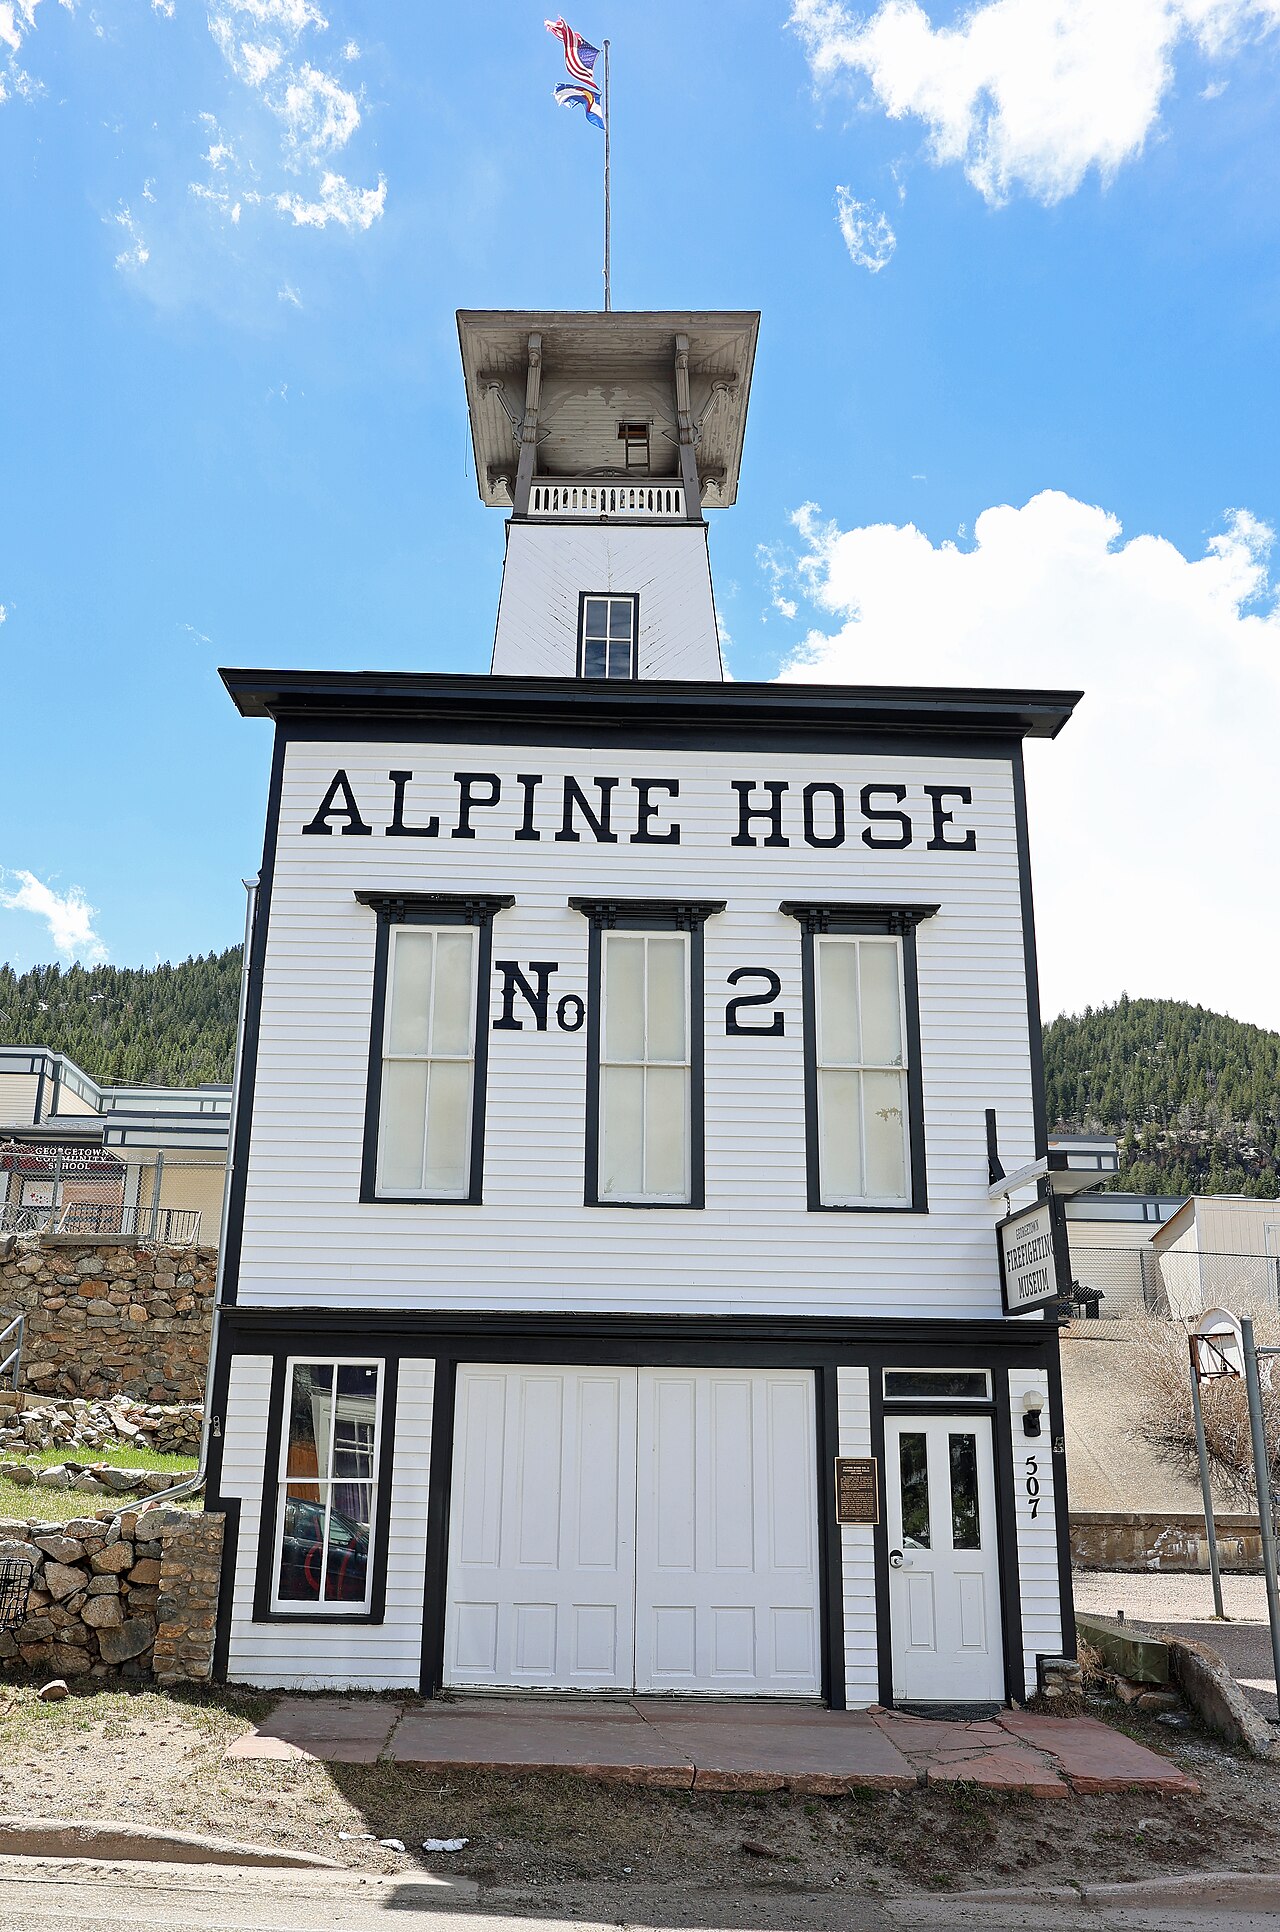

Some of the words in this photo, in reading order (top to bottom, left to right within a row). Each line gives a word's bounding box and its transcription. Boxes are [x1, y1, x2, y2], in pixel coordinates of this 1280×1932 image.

[302, 769, 681, 845] ALPINE
[731, 780, 977, 851] HOSE
[493, 961, 585, 1032] No
[726, 967, 785, 1037] 2
[1018, 1268, 1049, 1299] MUSEUM
[1025, 1455, 1041, 1520] 507
